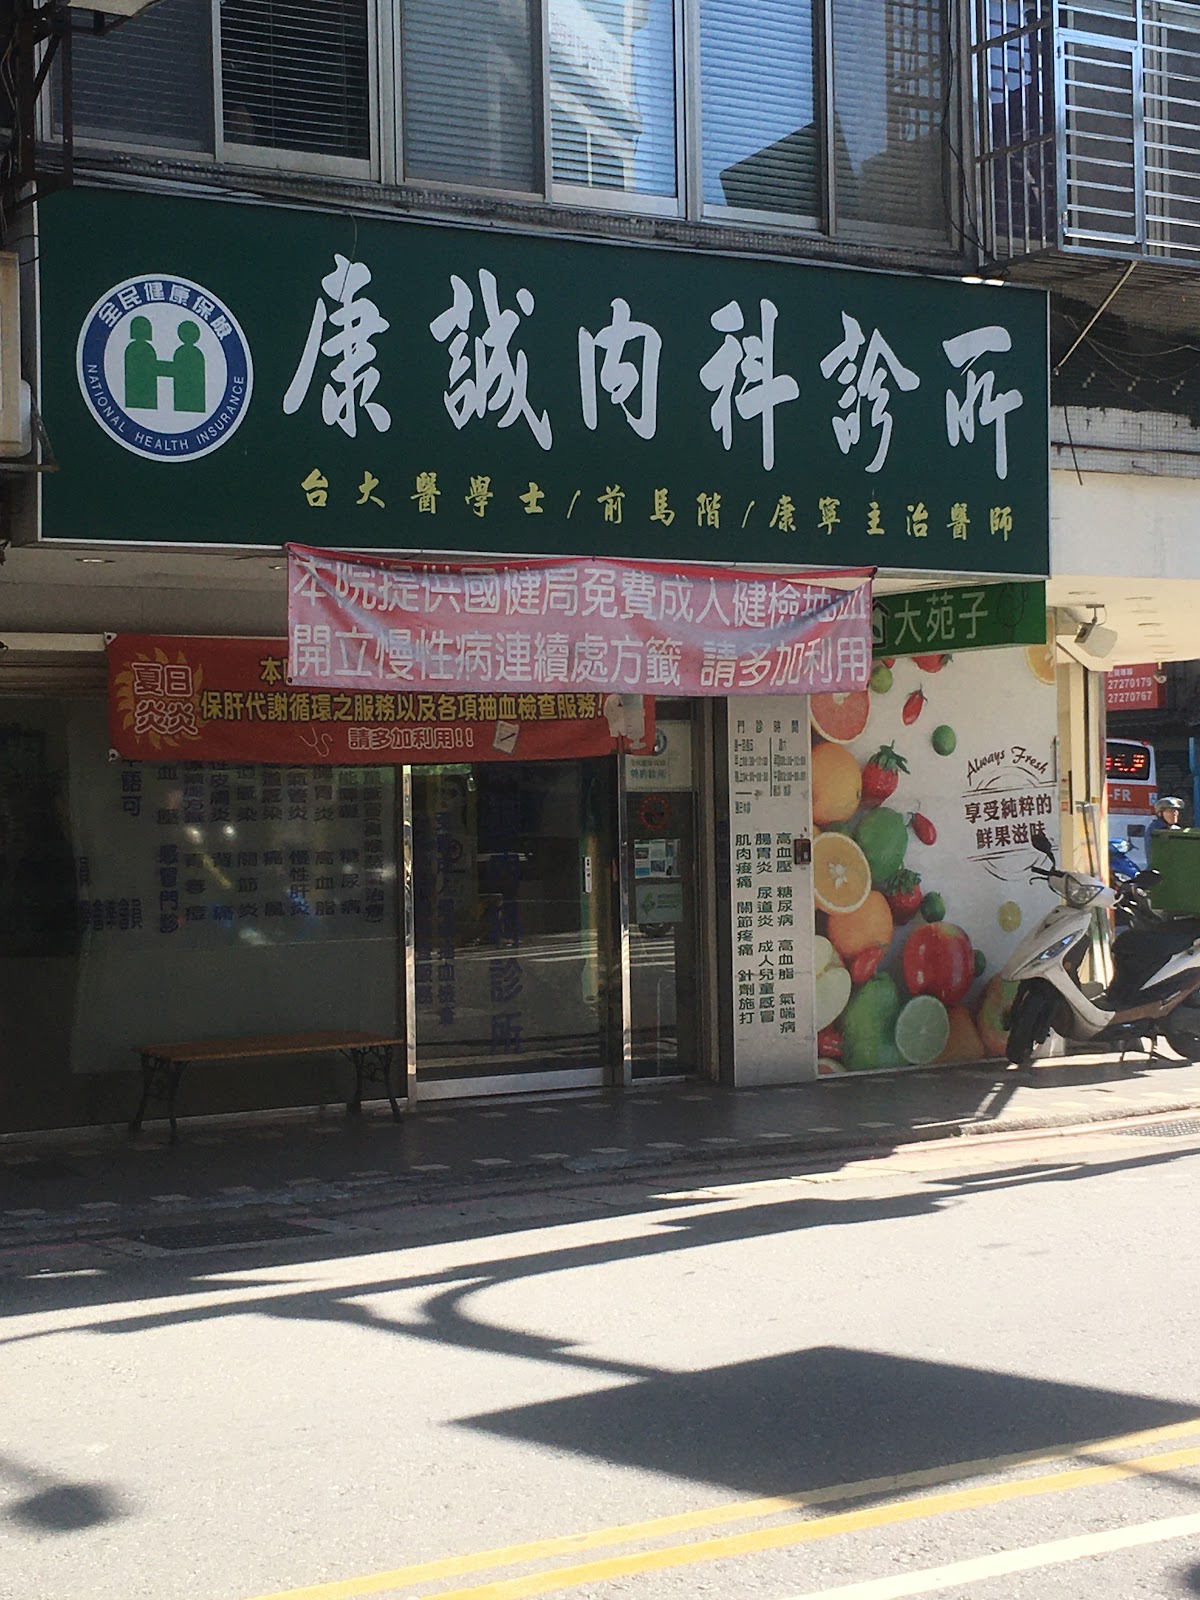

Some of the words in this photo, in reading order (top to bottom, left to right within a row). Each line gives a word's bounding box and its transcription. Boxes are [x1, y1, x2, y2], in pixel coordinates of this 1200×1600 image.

[98, 281, 233, 341] 全民健康保險
[283, 253, 1023, 480] 康誠內科診所
[87, 364, 126, 433] NATIONAL
[134, 431, 190, 452] HEALTH
[195, 375, 245, 445] INSURANCE
[894, 592, 988, 646] 大苑子
[293, 624, 683, 686] 開立慢性病連續處方籤
[700, 636, 867, 688] 請多加利用
[131, 662, 194, 697] 夏日
[1107, 690, 1152, 703] 27270767
[134, 699, 199, 735] 炎炎
[967, 750, 1006, 786] Always
[1011, 746, 1049, 774] Fresh
[964, 793, 1052, 824] 享受純粹的
[735, 834, 752, 888] 肌肉痠痛
[755, 833, 773, 874] 腸胃炎
[776, 832, 793, 873] 高血壓
[757, 886, 774, 927] 尿道炎
[776, 886, 794, 926] 糖尿病
[737, 901, 754, 956] 關節疼痛
[778, 939, 795, 980] 高血脂
[738, 969, 755, 1024] 針劑施打
[757, 940, 775, 1024] 成人兒童感冒
[779, 993, 796, 1034] 氣喘病
